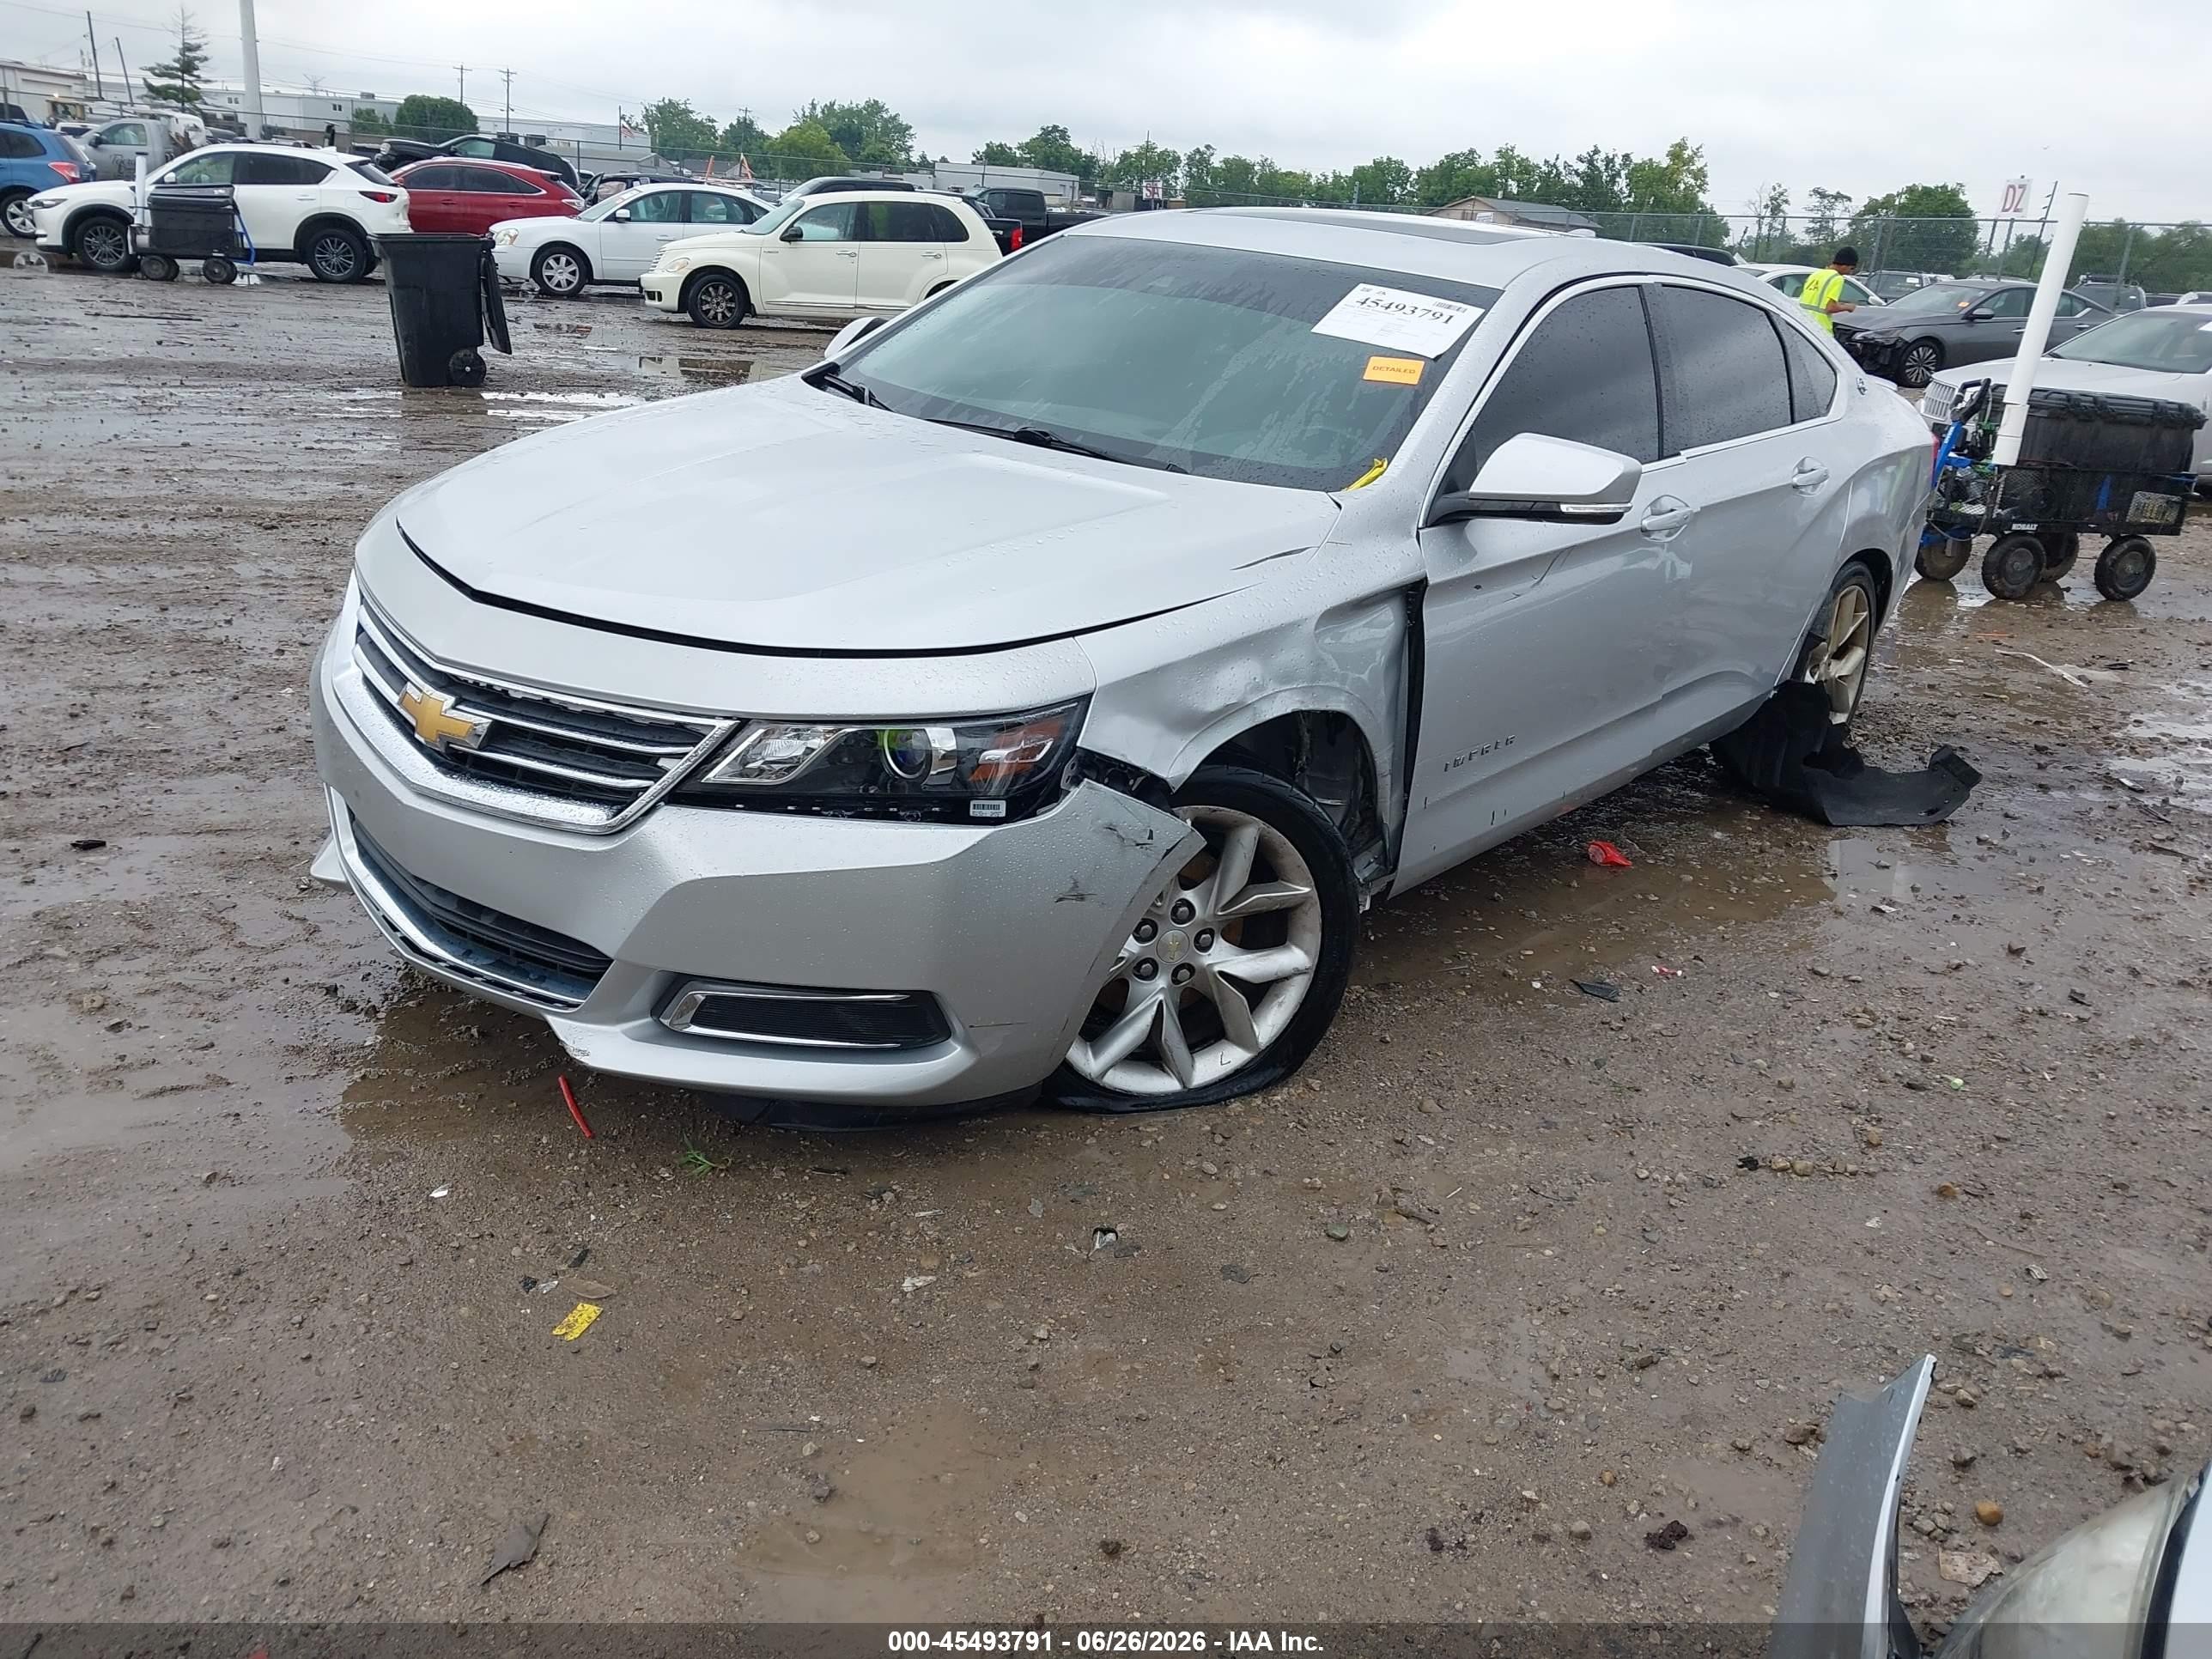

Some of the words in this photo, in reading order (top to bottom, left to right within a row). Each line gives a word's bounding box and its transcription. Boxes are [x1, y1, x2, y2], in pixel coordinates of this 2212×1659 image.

[1146, 183, 1159, 198] SA
[2001, 184, 2027, 213] DZ
[1356, 296, 1455, 325] 45493791
[1372, 366, 1416, 374] DETAILED
